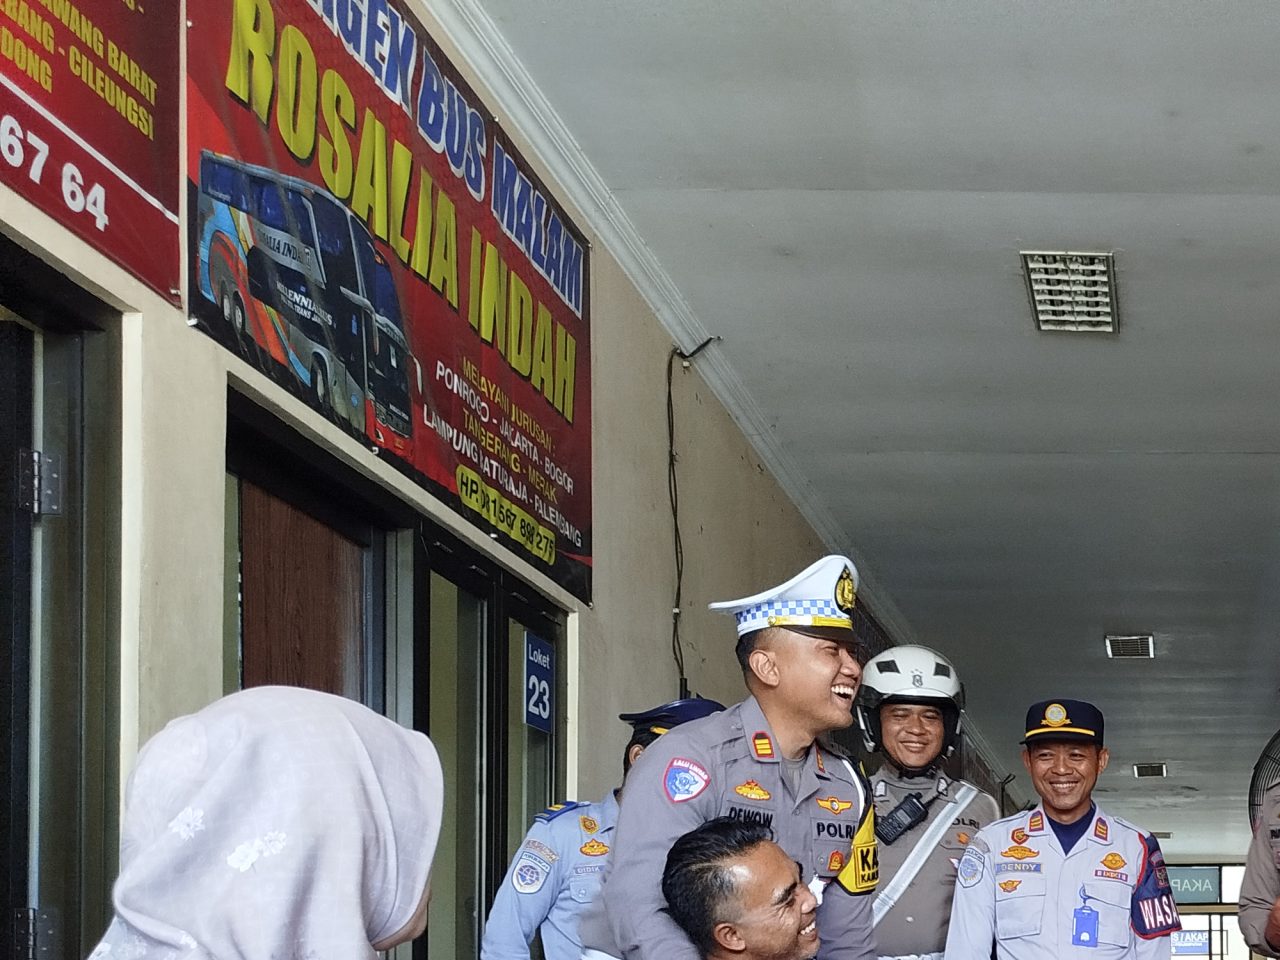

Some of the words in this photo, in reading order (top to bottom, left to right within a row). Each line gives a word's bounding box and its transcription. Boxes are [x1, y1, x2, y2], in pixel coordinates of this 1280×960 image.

[69, 45, 154, 141] CILEUNGSI
[107, 40, 157, 106] BARAT
[0, 115, 49, 185] 67
[61, 162, 109, 232] 64
[225, 0, 459, 310] ROSALIA
[468, 225, 576, 424] INDAH
[417, 47, 486, 202] BUS
[491, 137, 584, 320] MALAM
[463, 356, 510, 415] MELAYANI
[511, 403, 552, 453] JURUSAN
[424, 404, 478, 464] LAMPUNG
[535, 494, 582, 548] PALEMBANG
[463, 408, 520, 474] TANGERANG
[528, 464, 558, 504] MERAK
[545, 457, 574, 495] BOGOR
[528, 643, 550, 670] Loket
[528, 674, 550, 719] 23
[952, 818, 980, 829] OLRI
